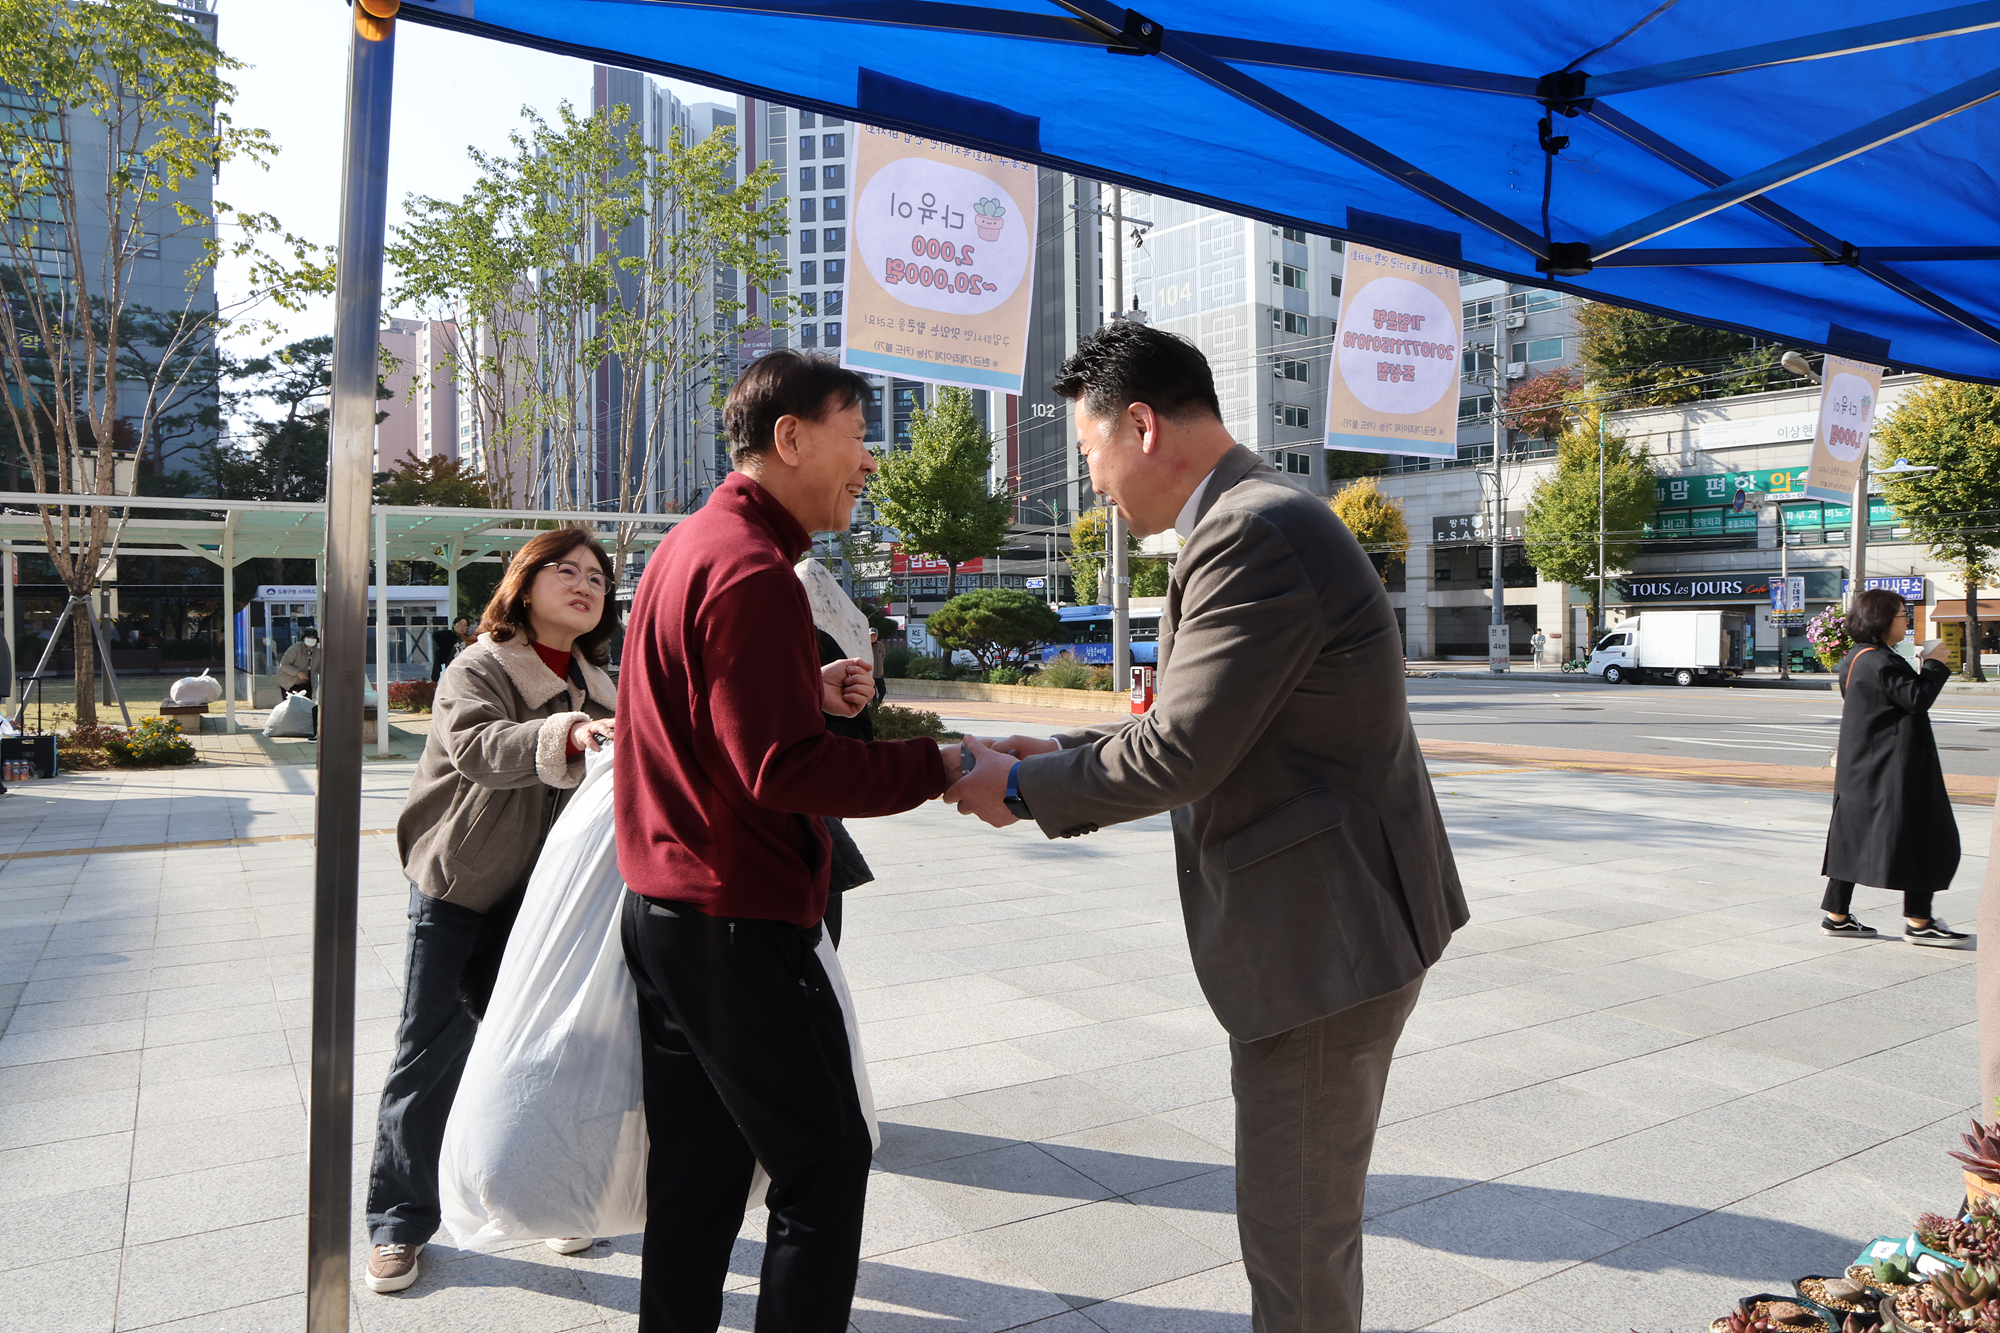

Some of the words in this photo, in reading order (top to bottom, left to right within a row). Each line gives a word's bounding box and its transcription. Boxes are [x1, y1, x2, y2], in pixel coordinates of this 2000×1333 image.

[1158, 281, 1194, 309] 104
[1031, 403, 1056, 418] 102
[1692, 516, 1722, 528] 정형외과
[1629, 582, 1671, 597] TOUS
[1673, 582, 1689, 595] les
[1691, 580, 1742, 598] JOURS
